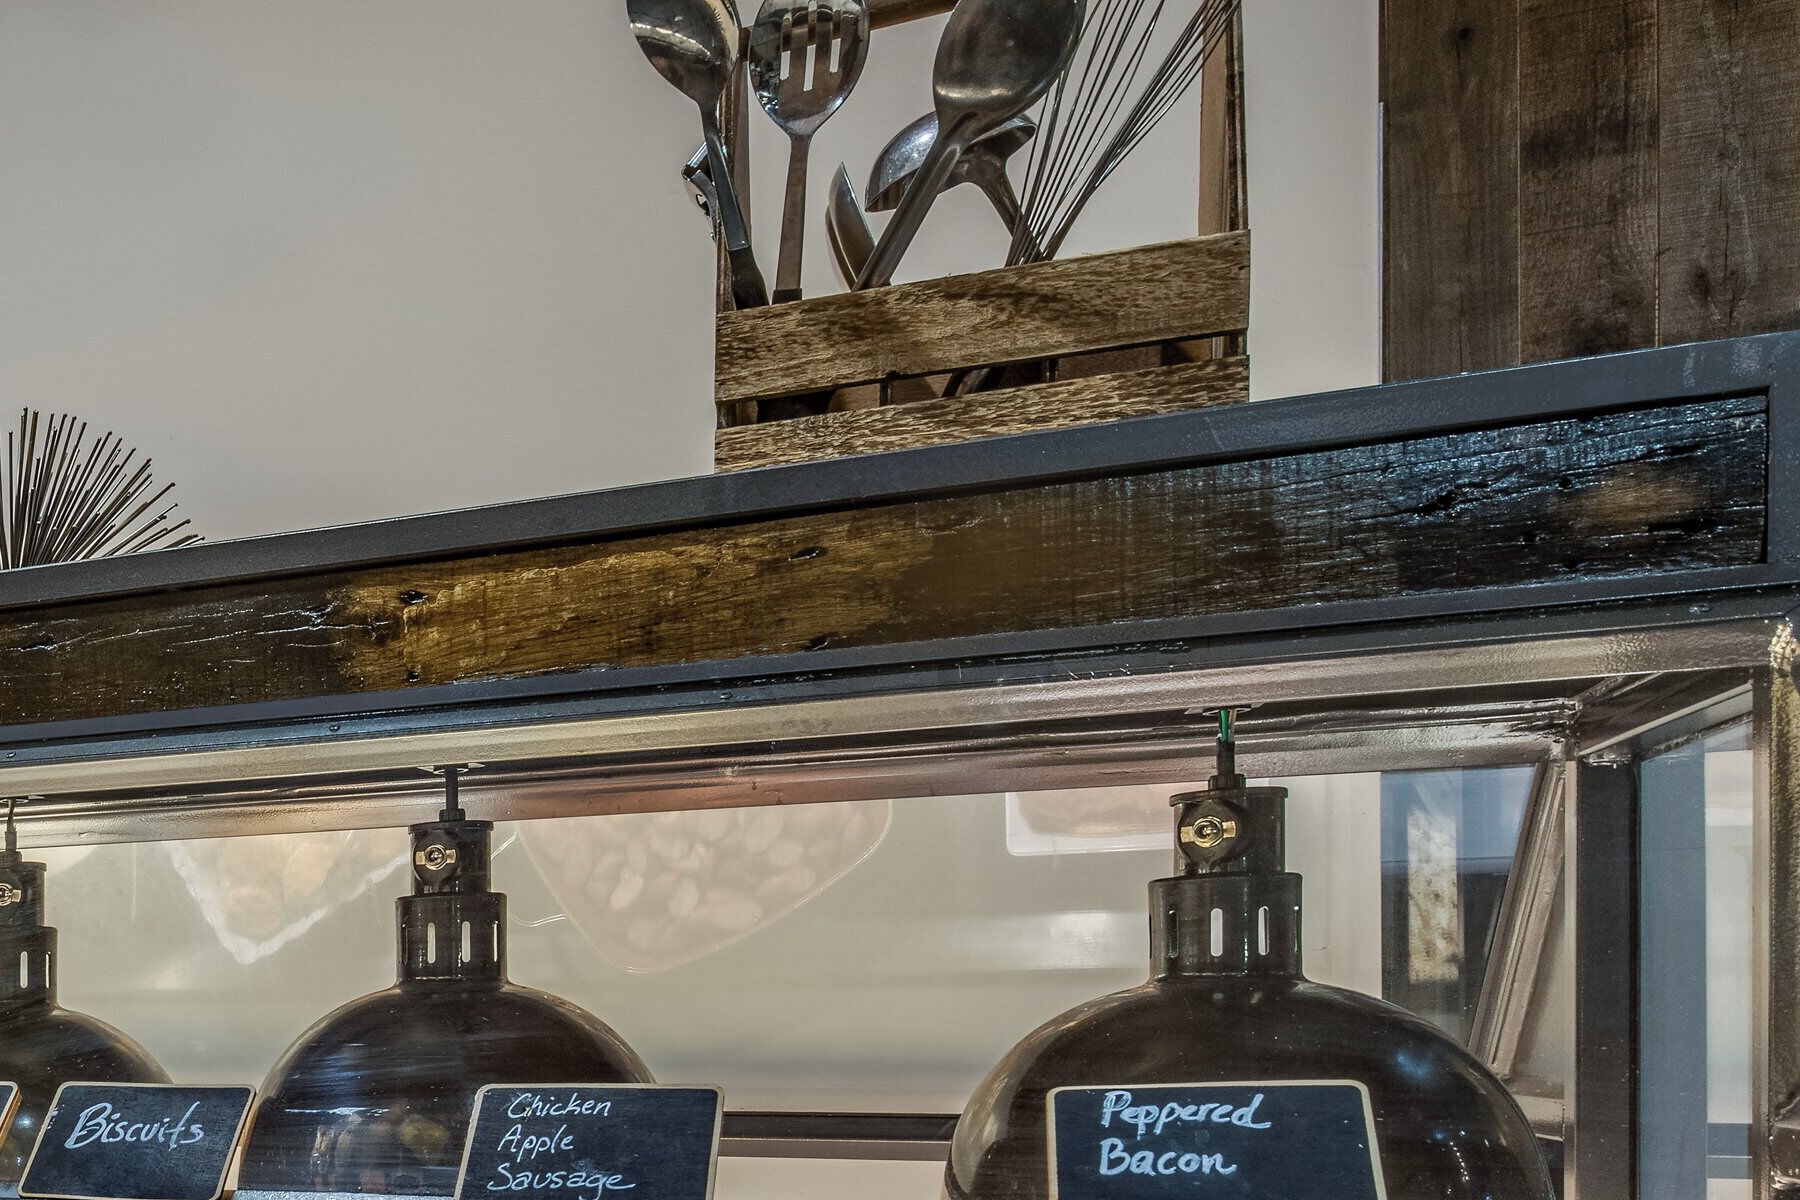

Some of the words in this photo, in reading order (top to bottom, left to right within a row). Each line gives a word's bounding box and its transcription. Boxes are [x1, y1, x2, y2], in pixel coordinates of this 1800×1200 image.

[507, 1093, 612, 1119] Chicken
[1101, 1090, 1272, 1141] Peppered
[64, 1101, 205, 1151] Biscuits
[497, 1123, 574, 1162] Apple
[1100, 1138, 1237, 1177] Bacon
